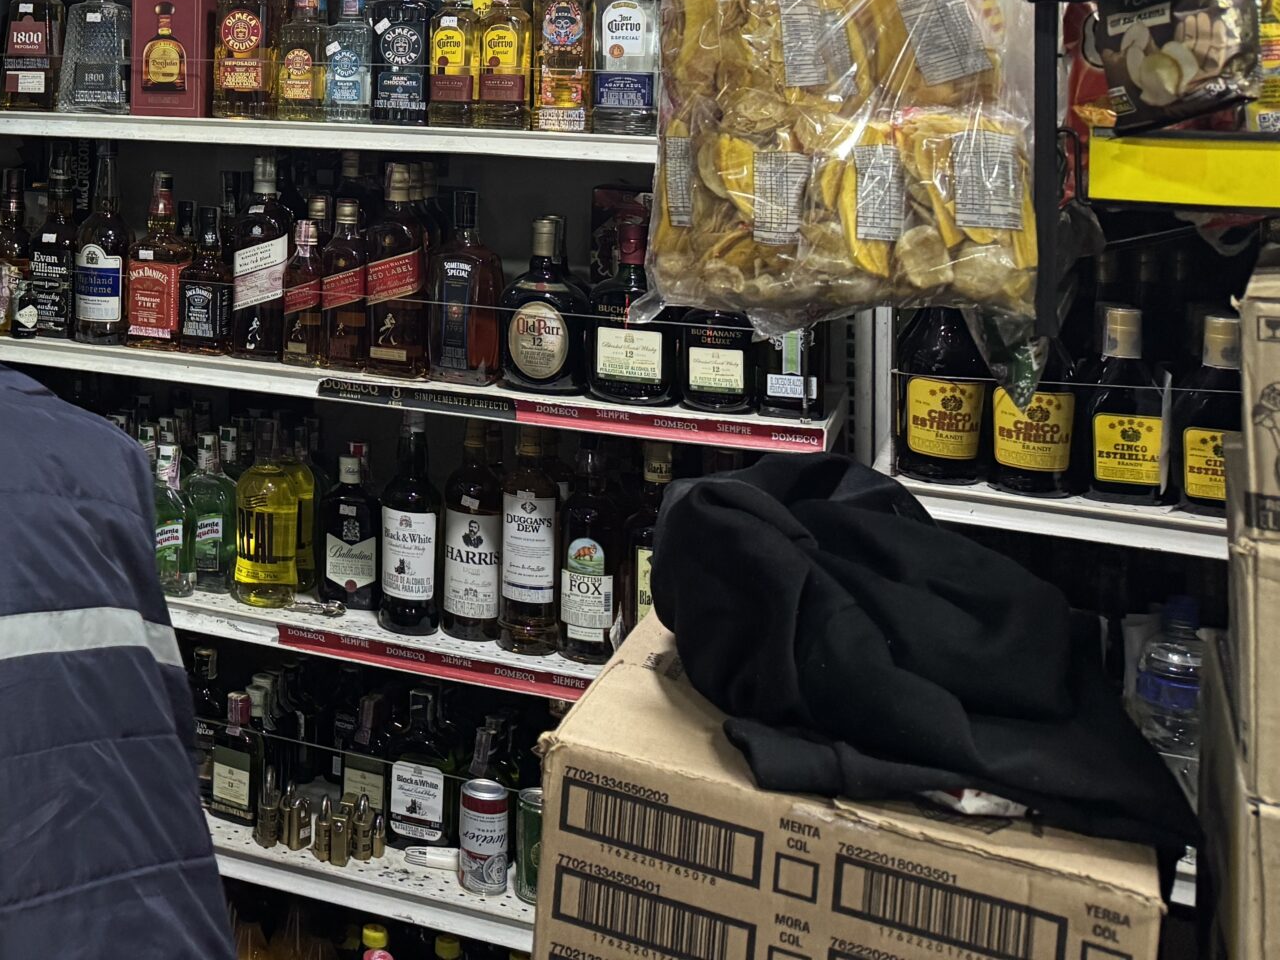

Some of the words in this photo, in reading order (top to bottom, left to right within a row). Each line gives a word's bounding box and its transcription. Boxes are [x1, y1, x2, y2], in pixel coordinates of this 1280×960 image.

[225, 11, 258, 28] OLMECA
[607, 20, 641, 34] Cuervo
[12, 31, 42, 45] 1800
[385, 26, 418, 43] OLMECA
[224, 37, 261, 52] TEQUILA
[436, 38, 462, 50] Cuervo
[487, 38, 513, 50] Cuervo
[84, 72, 105, 83] 1800
[33, 252, 58, 264] Evan
[368, 270, 384, 281] RED
[386, 264, 413, 278] LABEL
[443, 261, 472, 272] SOMETHING
[447, 268, 469, 278] SPECIAL
[516, 316, 535, 336] Old
[535, 316, 562, 337] Parr
[690, 327, 743, 339] BUCHANAN'S
[531, 336, 543, 347] 12
[623, 349, 634, 359] 12
[469, 397, 510, 411] PERFECTO
[535, 403, 579, 418] DOMECQ
[596, 408, 630, 421] SIEMPRE
[653, 418, 699, 432] DOMECQ
[716, 423, 752, 435] SIEMPRE
[771, 431, 818, 445] DOMECQ
[1109, 443, 1148, 453] CINCO
[506, 513, 552, 527] DUGGAN'S
[516, 524, 540, 533] DEW
[446, 545, 499, 566] HARRIS
[569, 580, 602, 596] FOX
[287, 628, 325, 642] DOMECQ
[386, 647, 426, 662] DOMECQ
[441, 655, 472, 668] SIEMPRE
[494, 667, 535, 683] DOMECQ
[552, 674, 586, 689] SIEMPRE
[565, 765, 669, 804] 77021334550203
[780, 818, 820, 840] MENTA
[787, 837, 811, 854] COL
[558, 853, 662, 895] 77021334550401
[775, 913, 811, 934] MORA
[1085, 903, 1132, 928] YERBA
[779, 932, 804, 949] COL
[1092, 925, 1119, 943] COL
